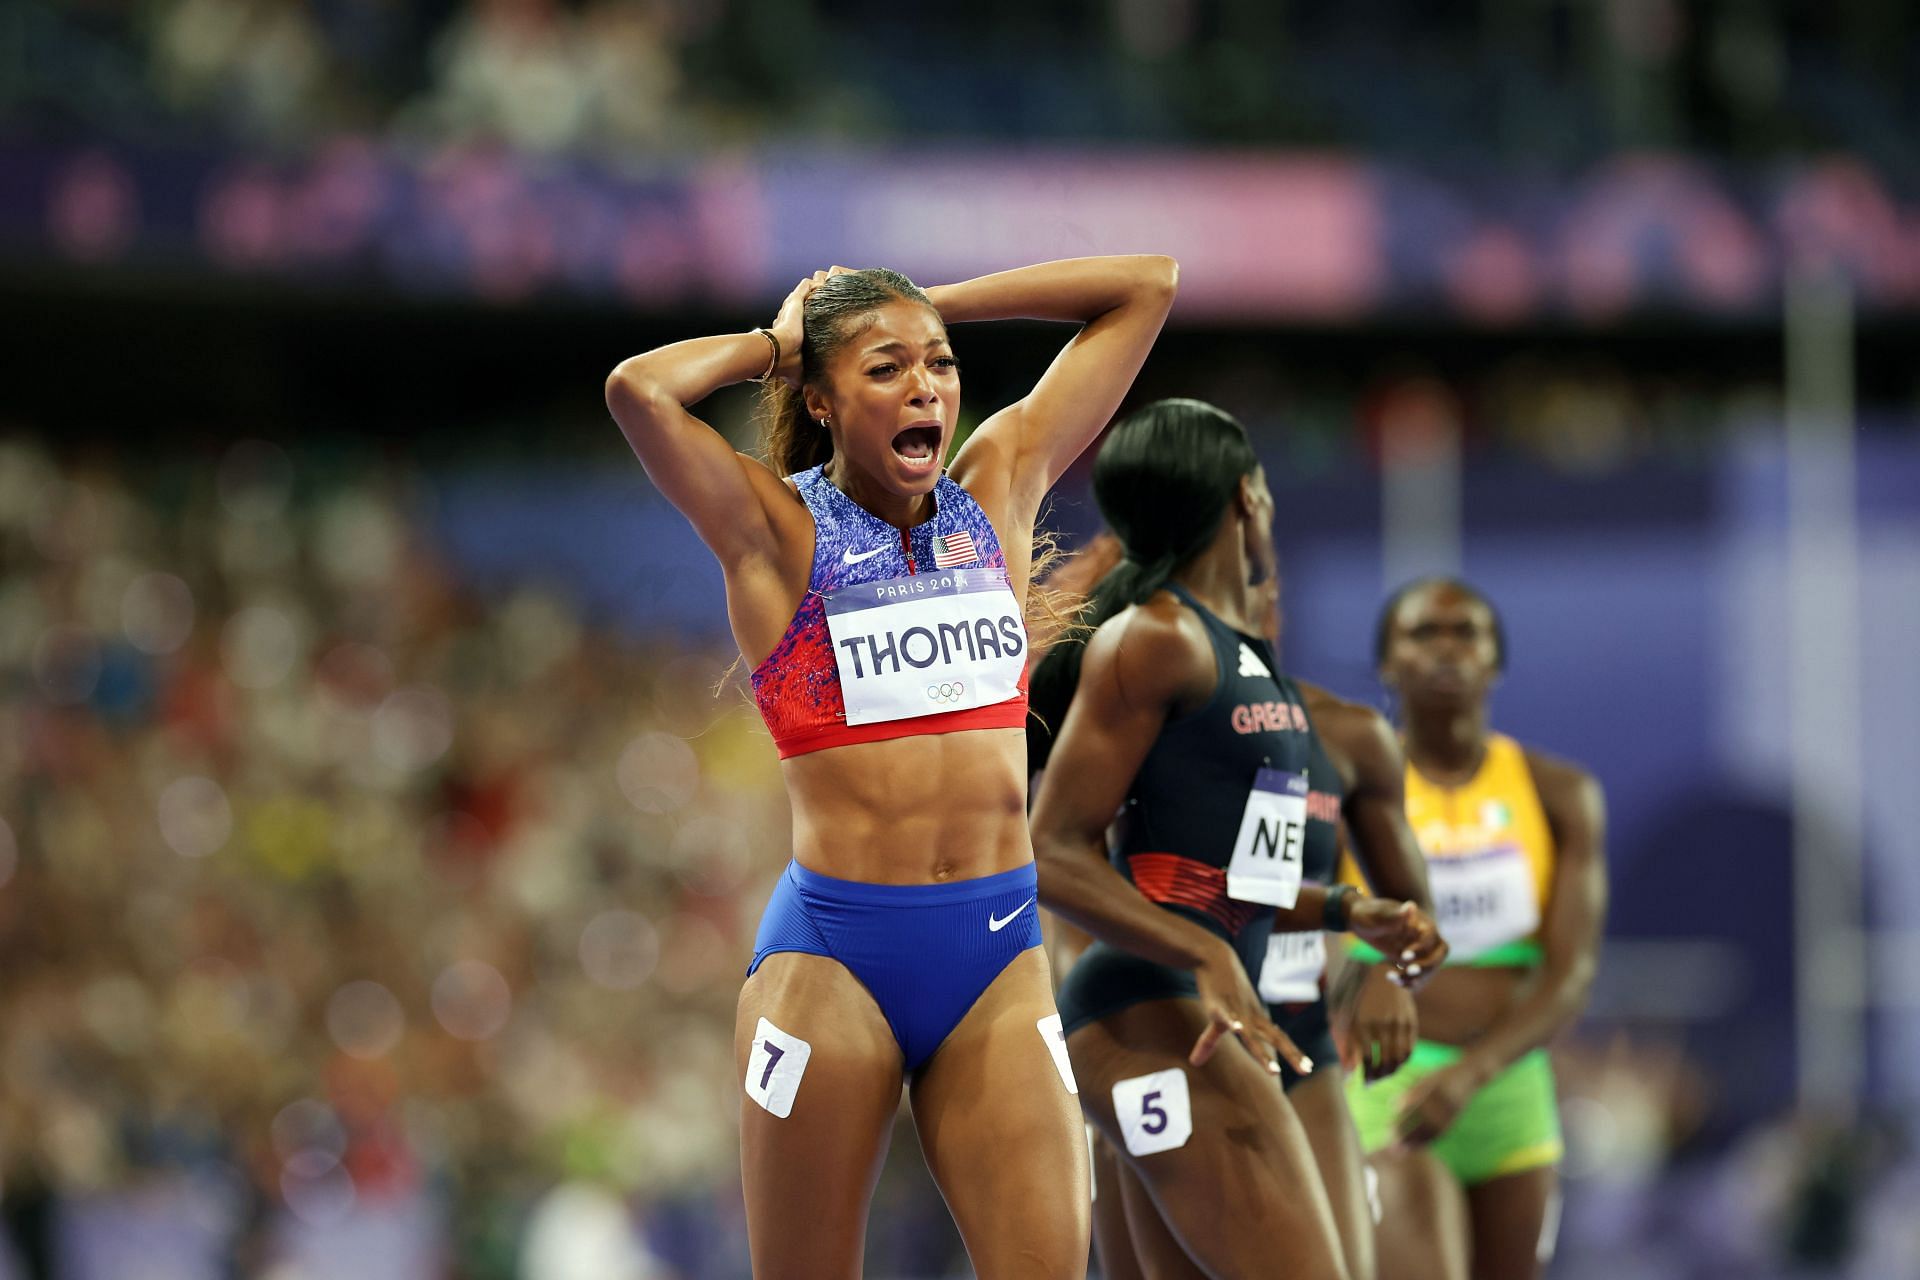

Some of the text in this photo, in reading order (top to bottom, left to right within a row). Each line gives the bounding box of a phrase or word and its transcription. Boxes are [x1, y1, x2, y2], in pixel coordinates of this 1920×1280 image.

[840, 615, 1023, 679] THOMAS
[760, 1040, 785, 1090] 7
[1141, 1090, 1168, 1135] 5
